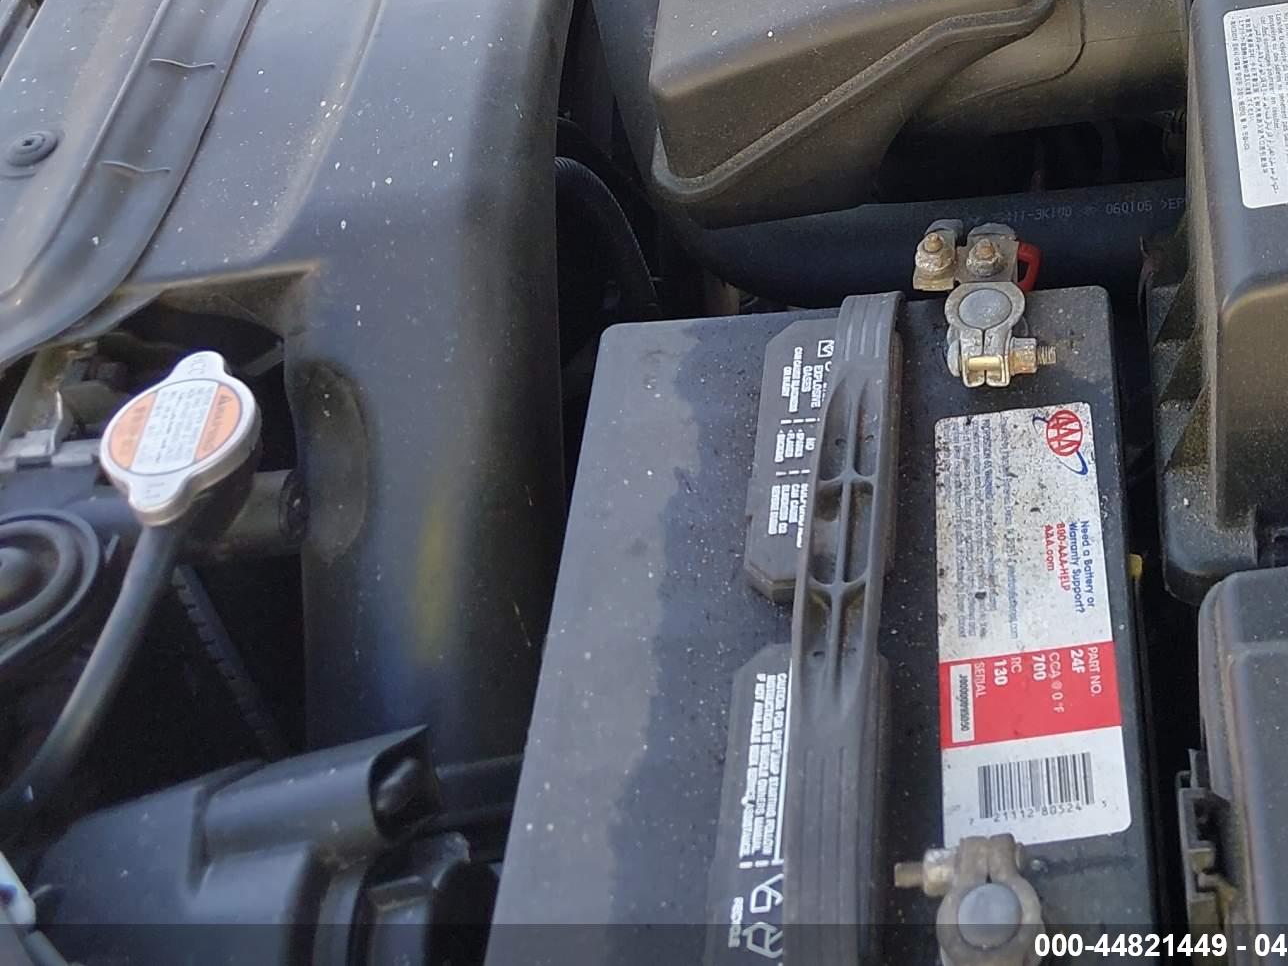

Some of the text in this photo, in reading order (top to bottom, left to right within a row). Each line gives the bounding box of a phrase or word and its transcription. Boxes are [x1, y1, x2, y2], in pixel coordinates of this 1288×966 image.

[799, 365, 813, 393] GASES
[809, 364, 824, 408] EXPLOSIVE
[804, 437, 816, 451] NO
[1046, 412, 1083, 455] AAA
[1043, 523, 1056, 571] AAA.com
[1079, 520, 1091, 546] Need
[1054, 522, 1070, 592] 800-AAA-HELP
[1065, 521, 1084, 614] Warranty Support?
[1080, 559, 1095, 594] Battery
[1086, 596, 1094, 607] or
[993, 658, 1007, 686] 130
[1010, 656, 1021, 673] RC
[1031, 653, 1046, 680] 700
[1048, 651, 1061, 678] CCA
[1069, 648, 1084, 674] 24F
[1087, 646, 1102, 696] PART NO.
[973, 661, 986, 698] SERIAL
[1052, 692, 1063, 700] 0
[993, 810, 1035, 823] 21112
[1041, 802, 1082, 816] 80524
